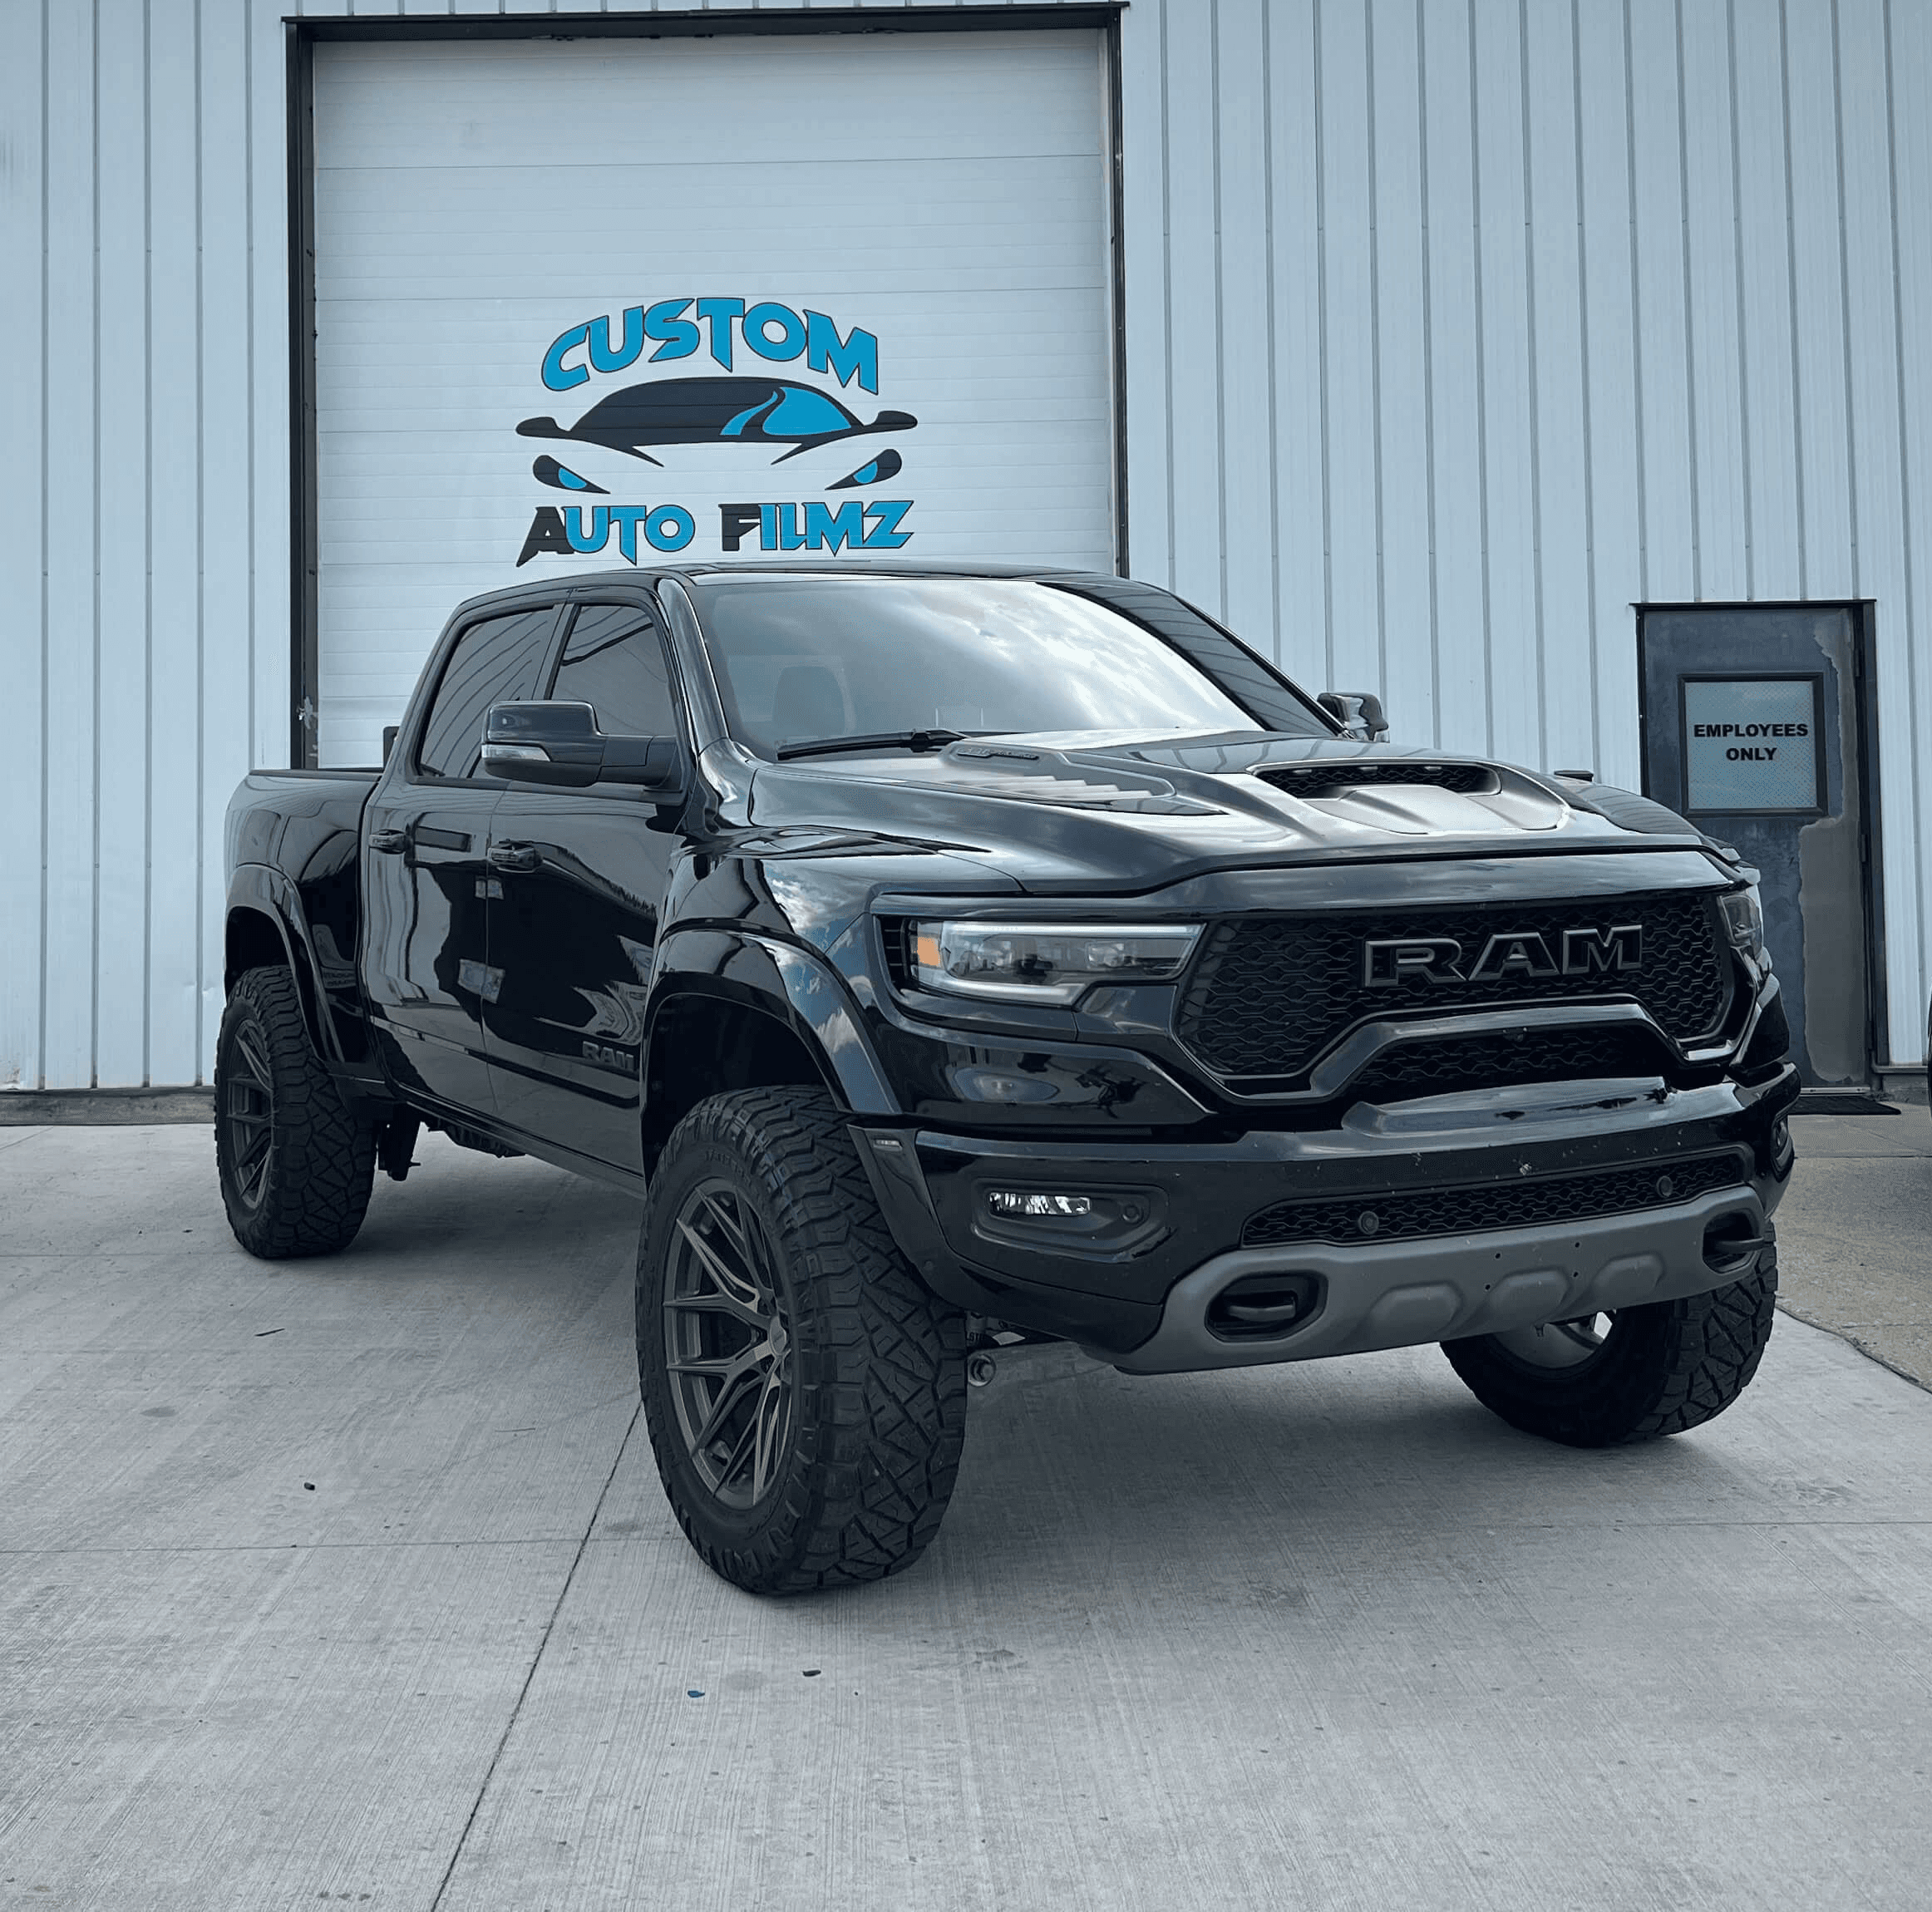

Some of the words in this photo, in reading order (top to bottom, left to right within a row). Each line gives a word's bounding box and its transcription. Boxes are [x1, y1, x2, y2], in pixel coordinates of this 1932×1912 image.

[541, 298, 878, 395] CUSTOM
[516, 505, 695, 567] AUTO
[718, 500, 914, 557] FILMZ
[1693, 723, 1809, 737] EMPLOYEES
[1726, 747, 1778, 761] ONLY
[1364, 924, 1643, 988] RAM
